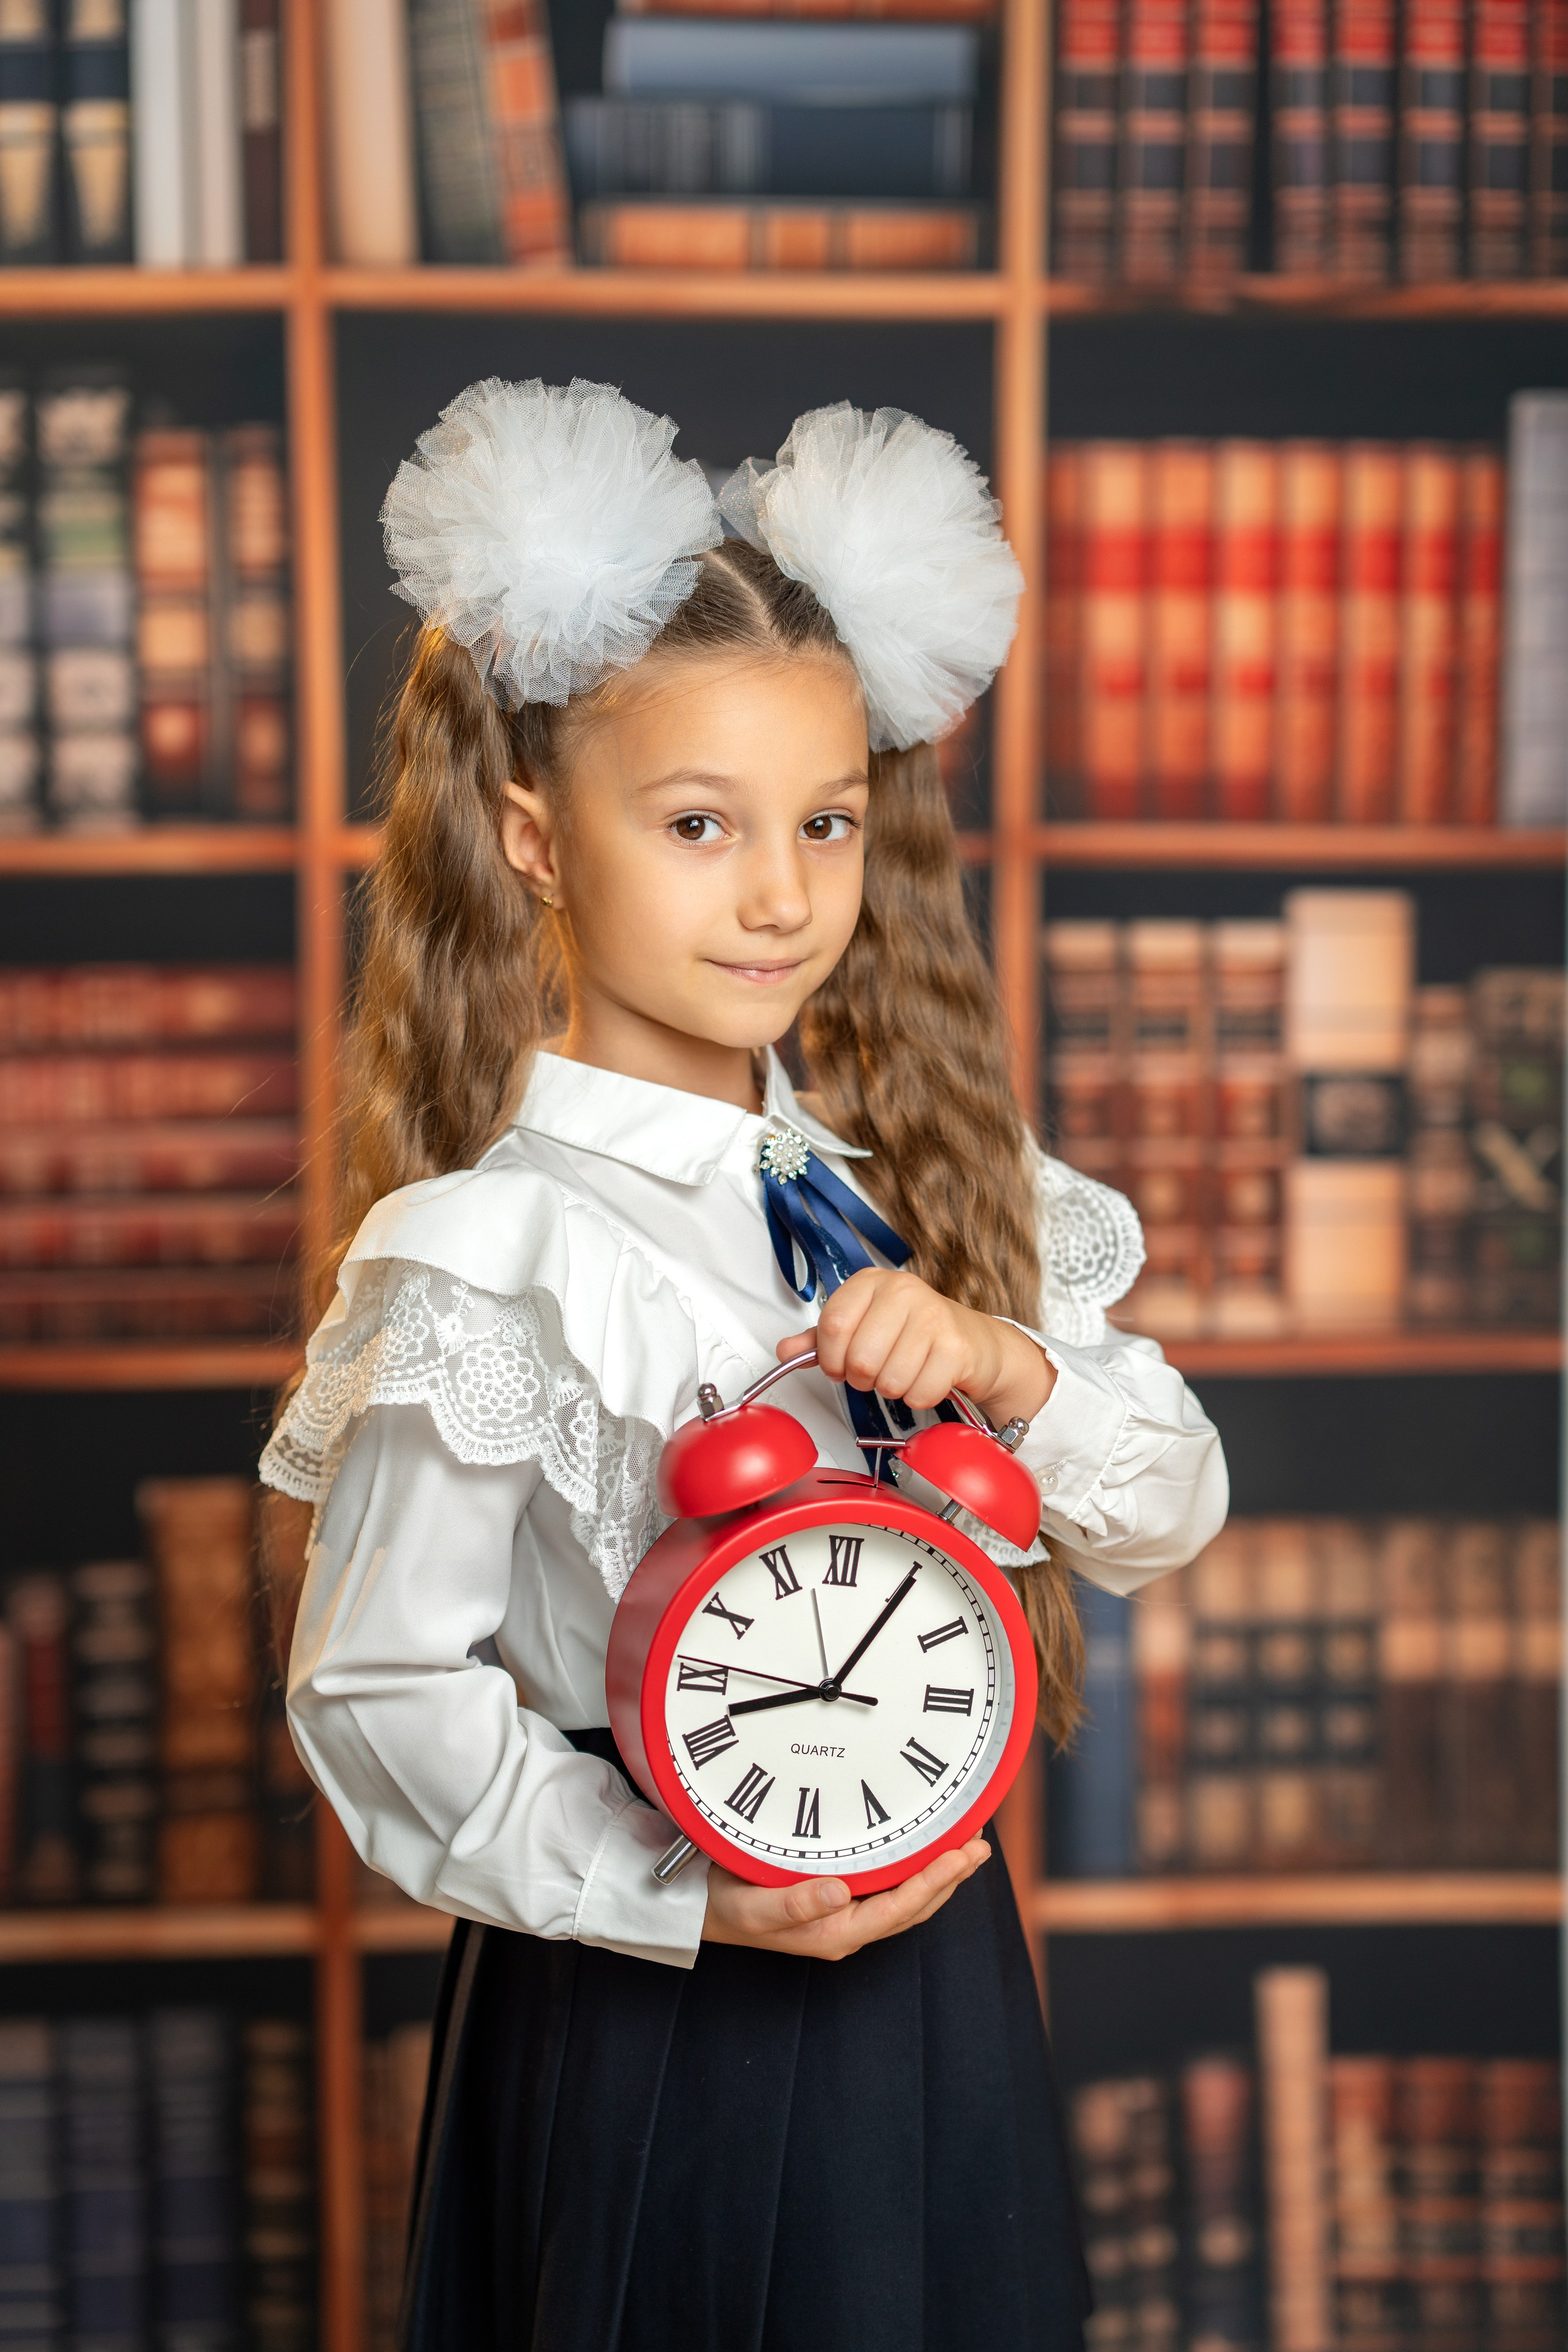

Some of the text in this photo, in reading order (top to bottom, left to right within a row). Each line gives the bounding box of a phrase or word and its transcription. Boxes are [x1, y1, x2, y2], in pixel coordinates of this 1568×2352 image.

[758, 1544, 803, 1600] XI
[822, 1534, 865, 1588] XII
[701, 1591, 755, 1640] X
[917, 1615, 969, 1654] II
[676, 1662, 729, 1695] IX
[922, 1684, 974, 1717] III
[682, 1714, 739, 1771] VIII
[790, 1743, 846, 1758] QUARTZ
[899, 1736, 950, 1788] IV
[723, 1762, 776, 1824] VII
[792, 1787, 821, 1839] VI
[861, 1779, 891, 1830] V
